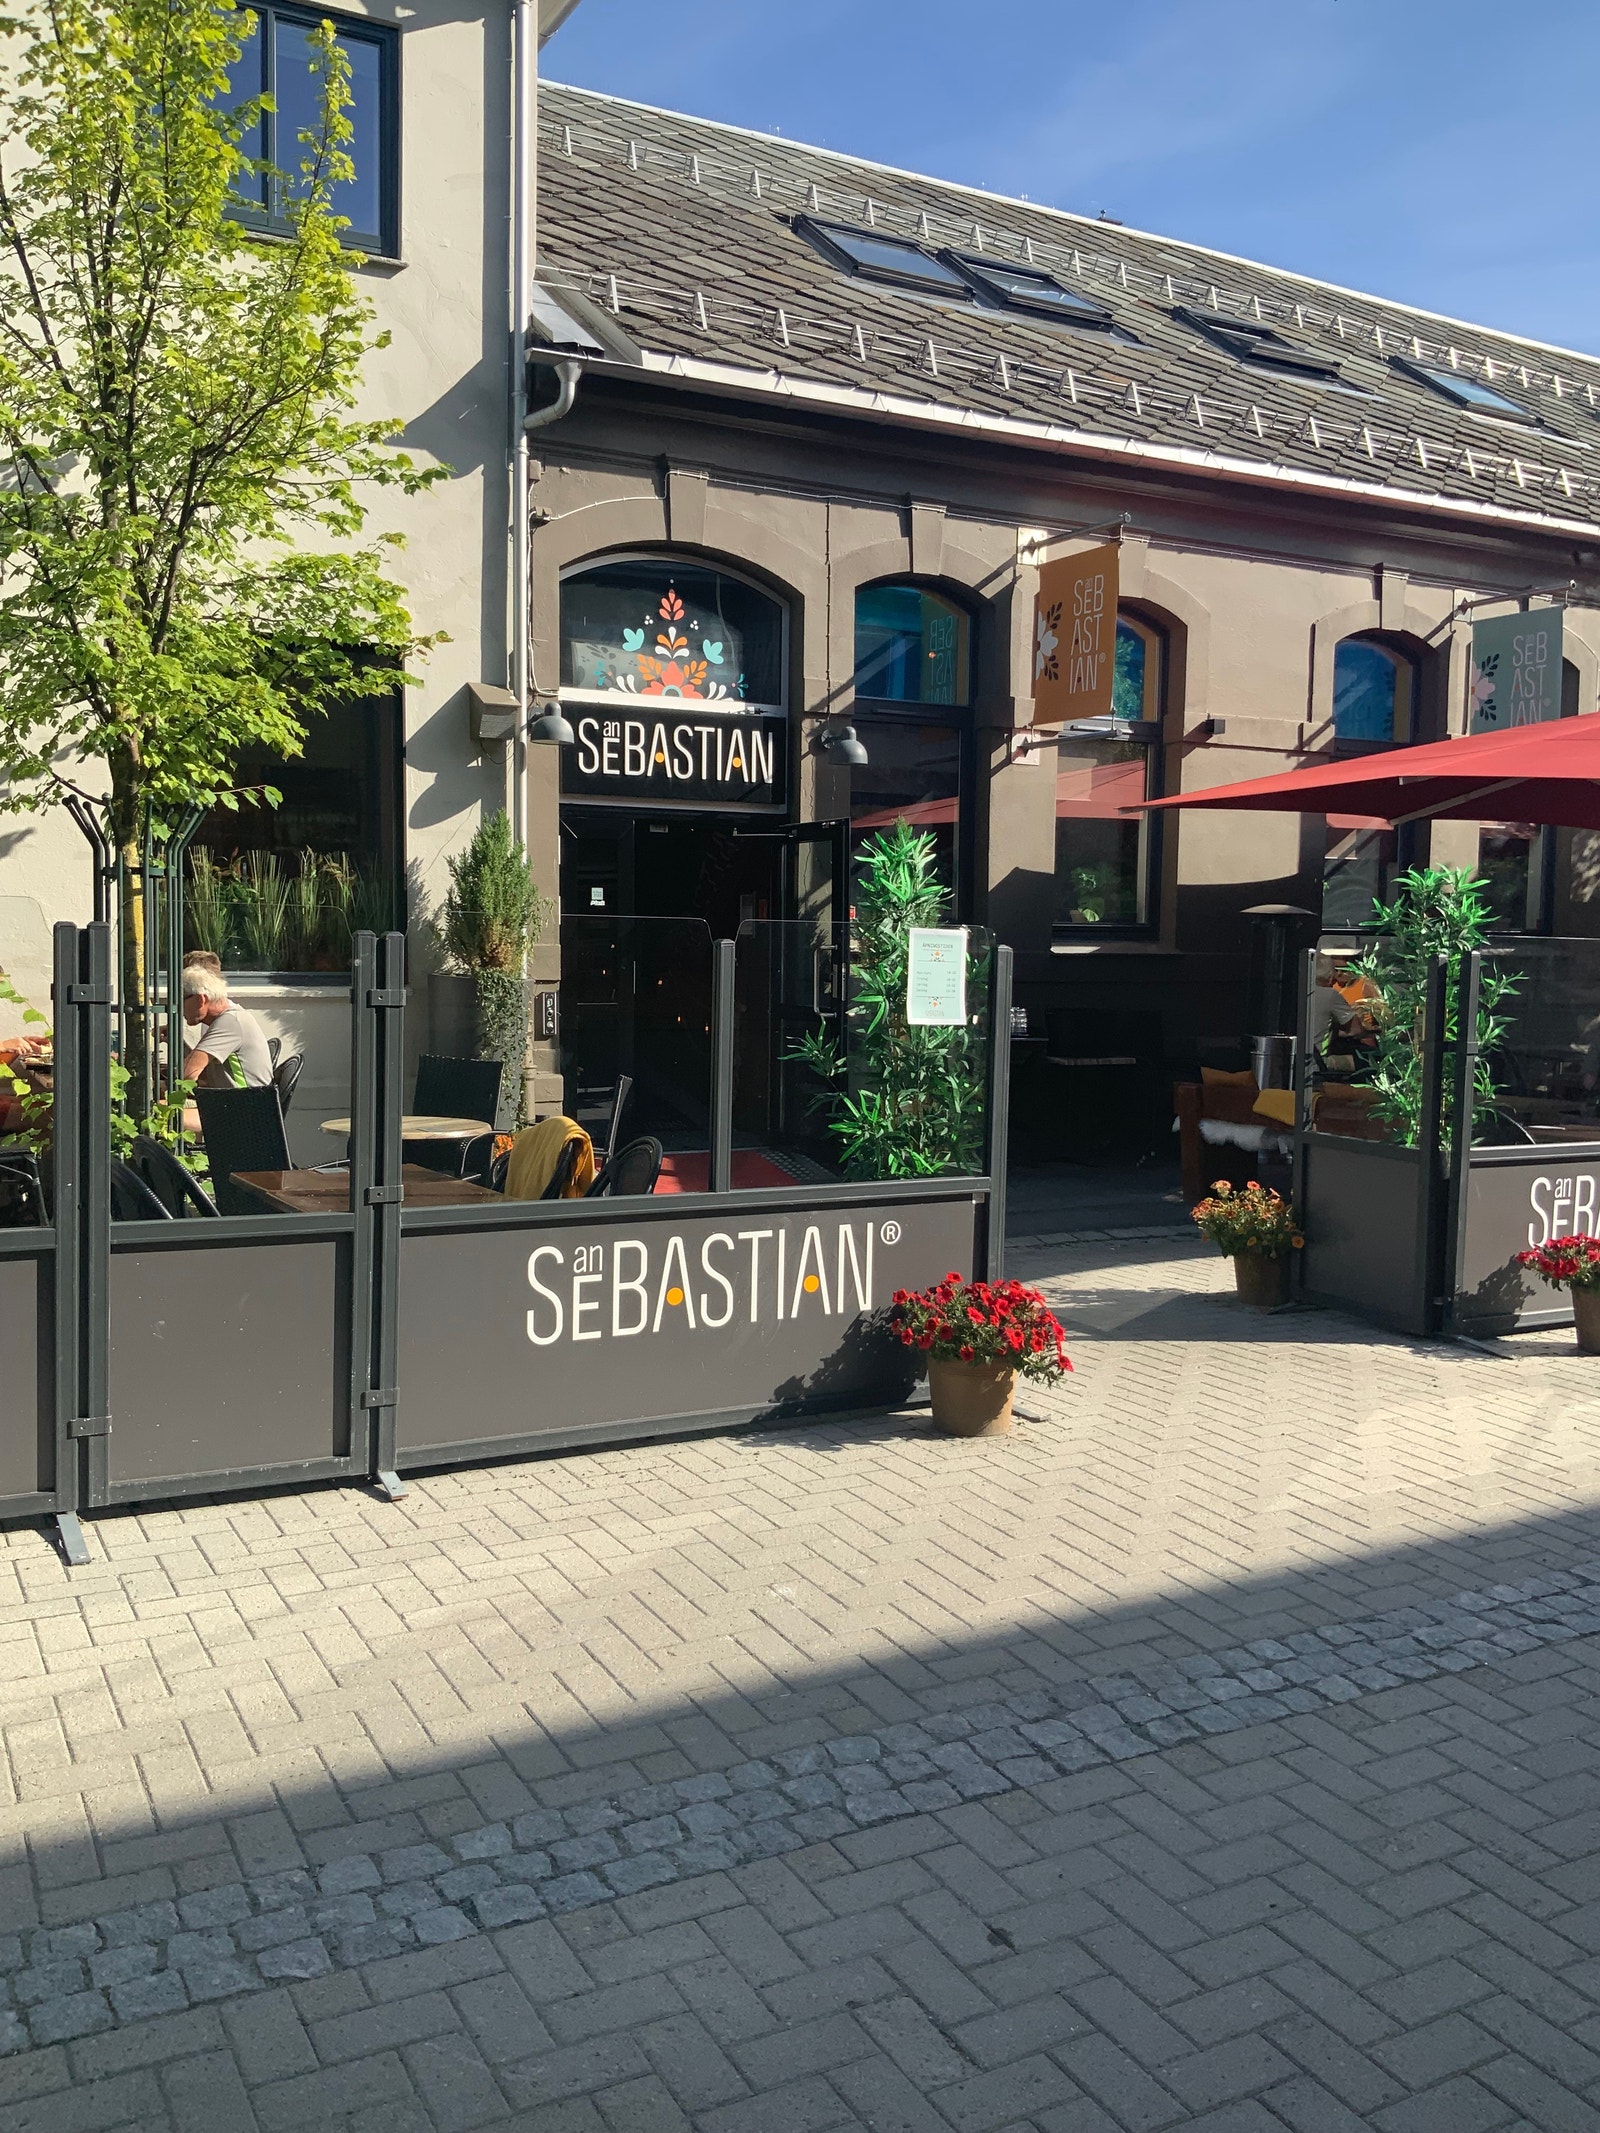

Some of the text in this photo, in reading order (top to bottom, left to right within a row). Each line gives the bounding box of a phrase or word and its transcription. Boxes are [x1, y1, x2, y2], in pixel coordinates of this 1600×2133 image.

[1073, 574, 1104, 617] SEB
[1070, 613, 1104, 656] AST
[1512, 631, 1547, 667] SEB
[1510, 664, 1547, 700] AST
[577, 717, 774, 785] SEBASTIAN
